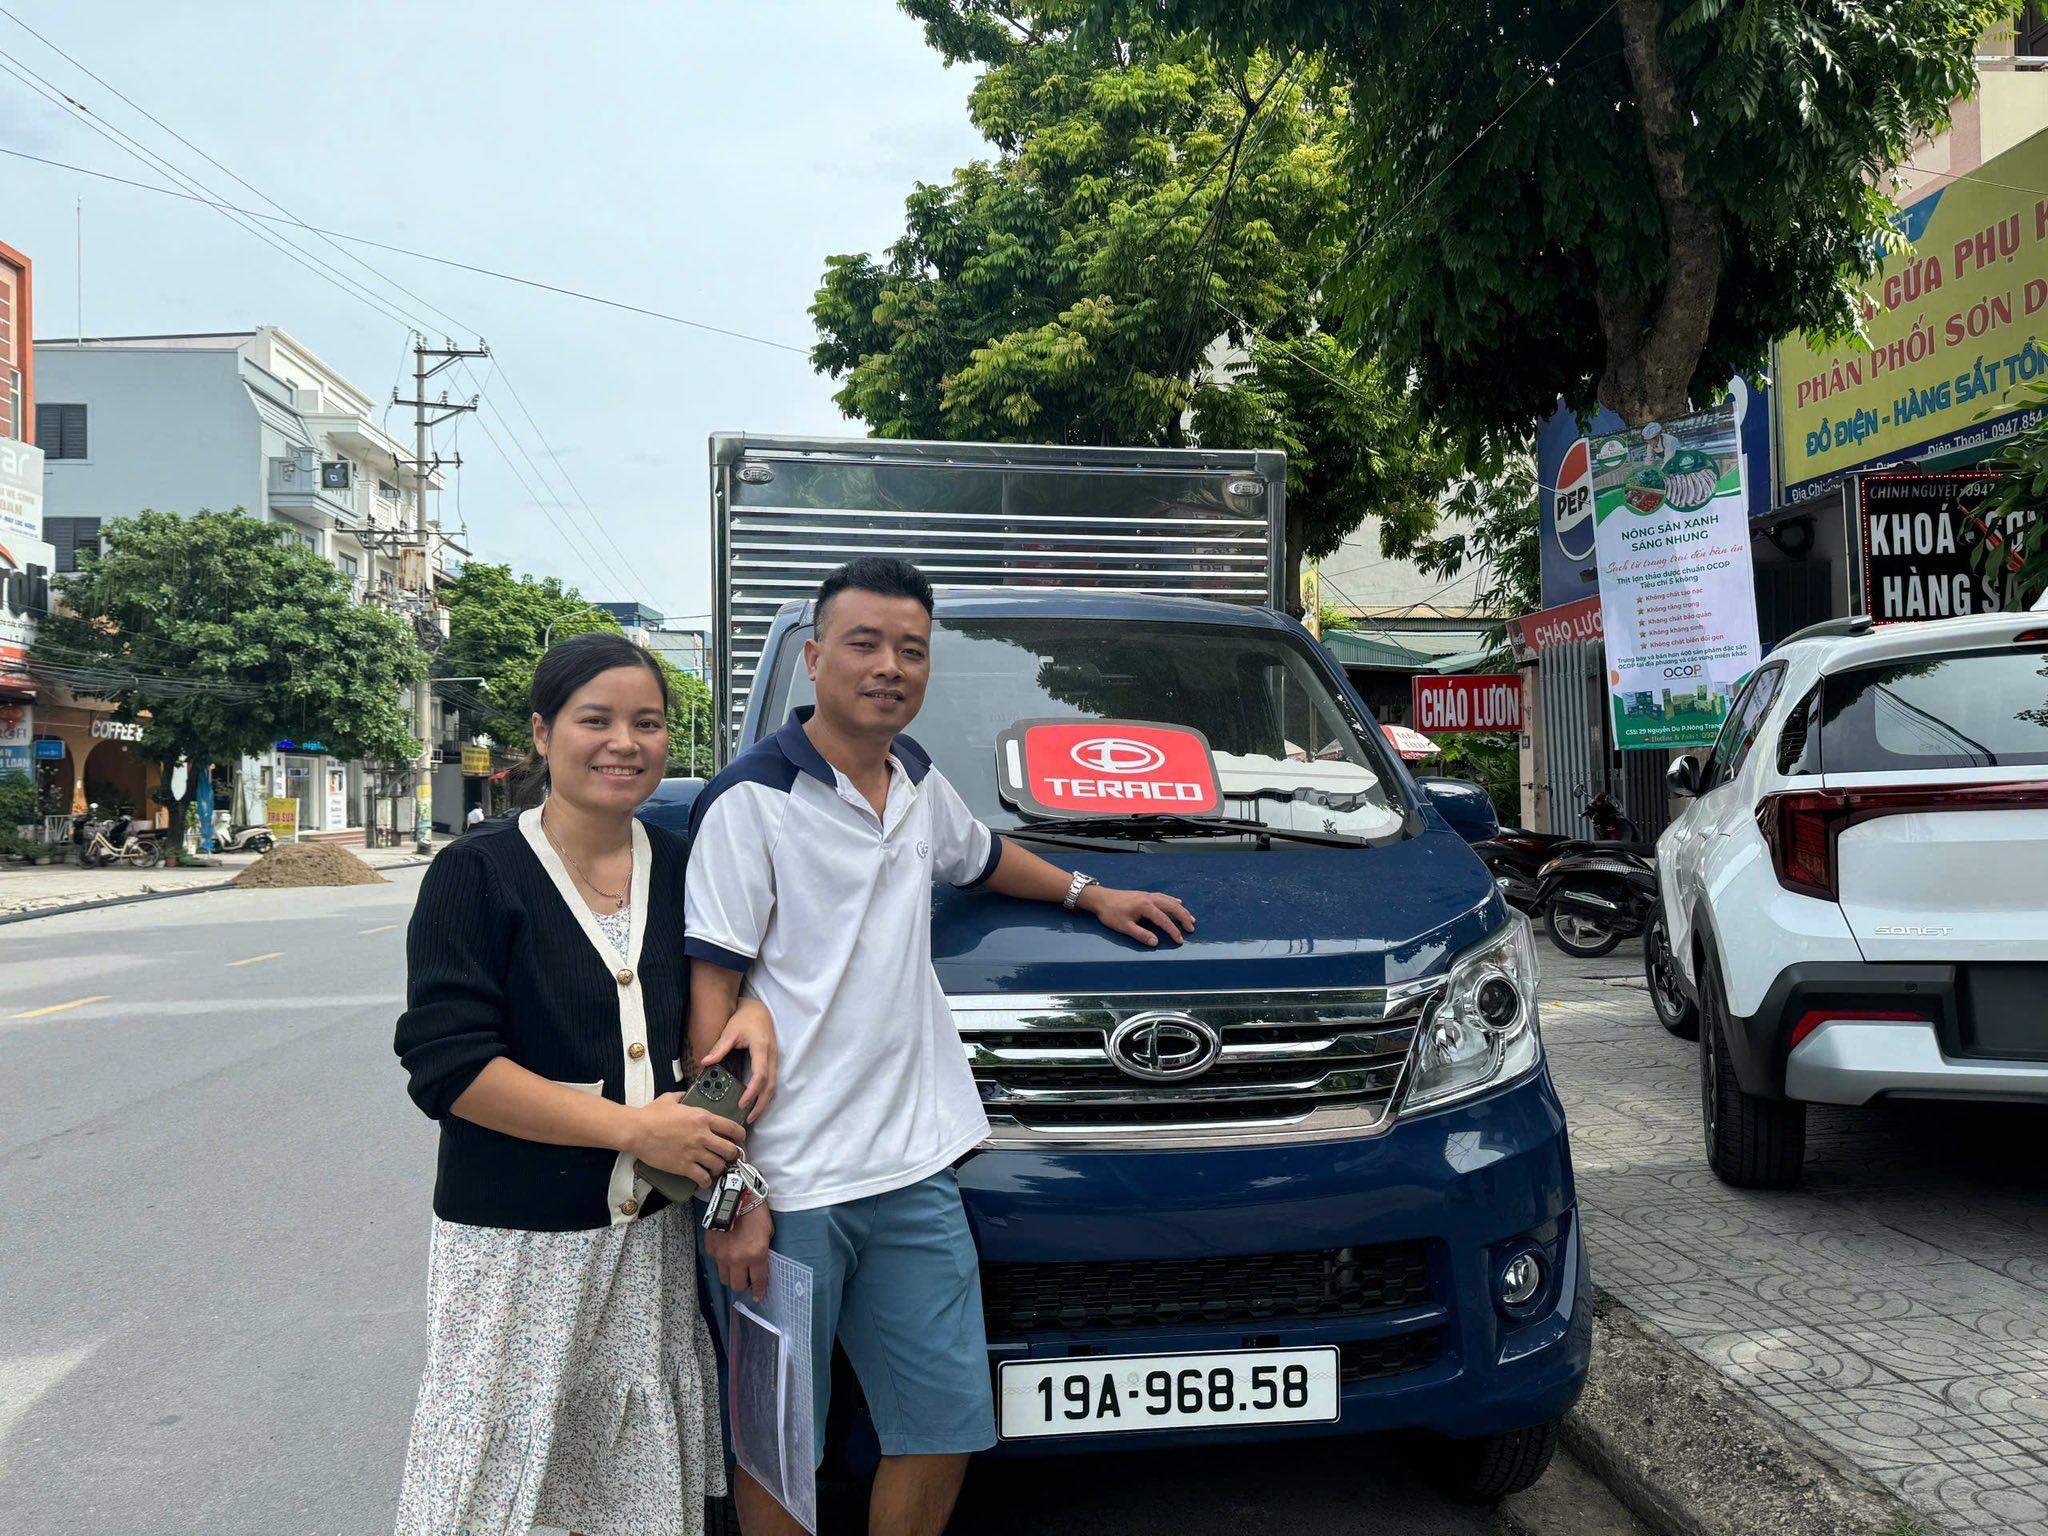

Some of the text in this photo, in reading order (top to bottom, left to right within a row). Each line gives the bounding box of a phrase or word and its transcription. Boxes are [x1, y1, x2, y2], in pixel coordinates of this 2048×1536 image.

[1884, 256, 1943, 311] CỬA
[1954, 213, 2019, 279] PHỤ
[1797, 359, 1863, 409] PHÂN
[1871, 314, 1936, 379] PHỐI
[1945, 296, 2013, 347] SƠN
[1806, 416, 1832, 458] ĐỒ
[1834, 408, 1879, 446] ĐIỆN
[1893, 388, 1951, 427] HÀNG
[1955, 355, 2001, 405] SẮT
[1557, 486, 1591, 521] PEP
[1621, 515, 1719, 541] NÔNG SẢN XANH
[1631, 530, 1709, 552] SÁNG NHUNG
[1870, 503, 1956, 556] KHOÁ
[1707, 561, 1730, 570] OCOP
[1640, 581, 1656, 589] Tiêu
[1657, 579, 1668, 587] chí
[1675, 575, 1699, 584] không
[1883, 566, 1972, 617] HÀNG
[1535, 618, 1572, 647] CHÁO
[1663, 665, 1702, 678] OCOP
[1421, 680, 1520, 728] CHÁO LƯƠN
[1044, 778, 1203, 801] TERACO
[1874, 926, 1954, 936] SONET
[1037, 1364, 1308, 1422] 19A-968.58
